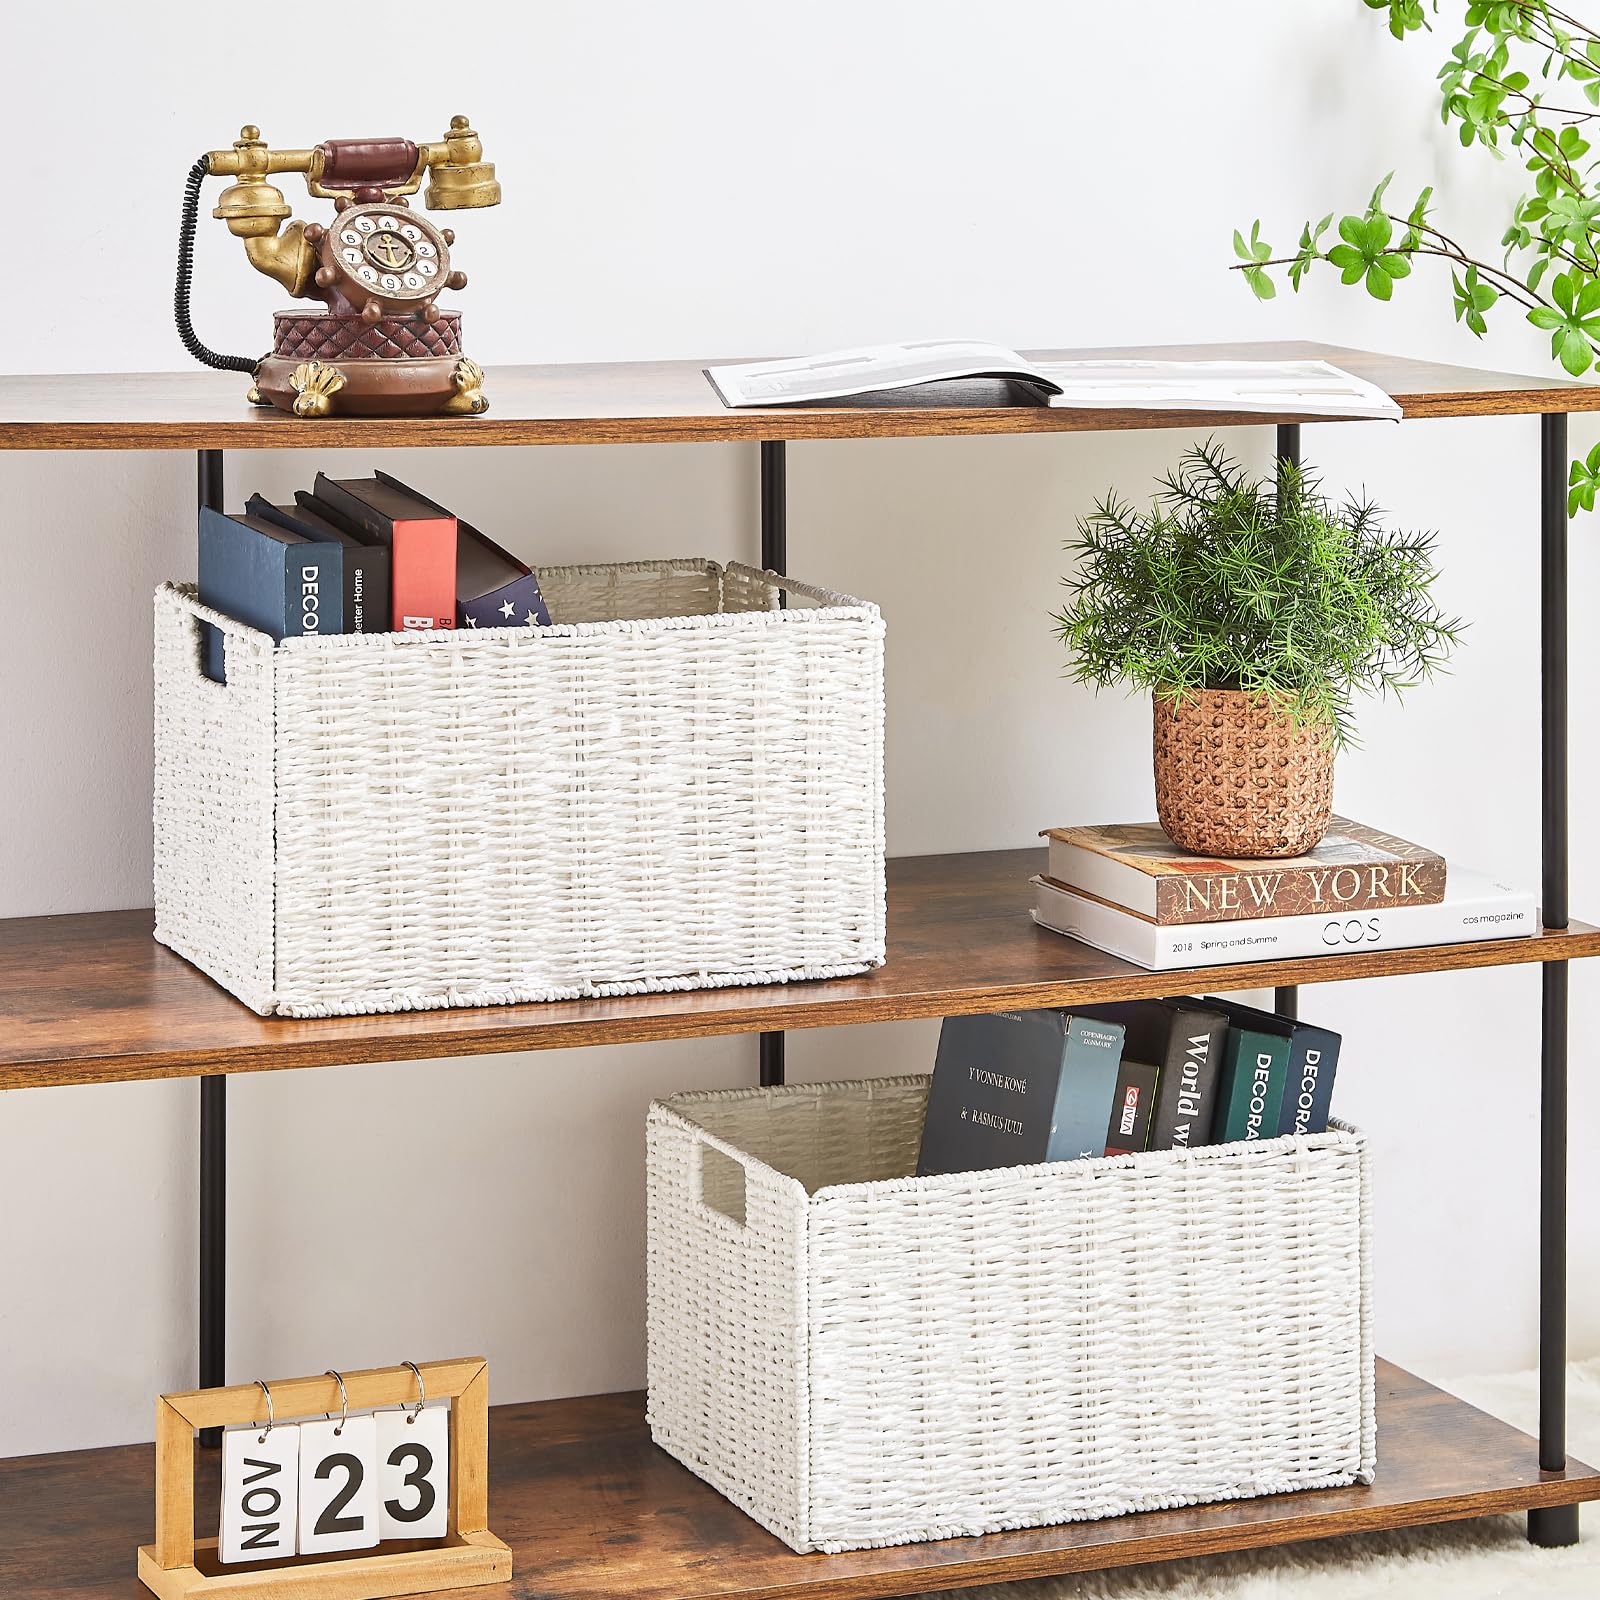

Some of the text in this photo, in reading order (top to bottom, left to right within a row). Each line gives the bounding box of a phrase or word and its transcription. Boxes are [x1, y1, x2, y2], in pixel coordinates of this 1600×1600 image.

[354, 569, 364, 602] Home
[302, 566, 319, 636] DECO
[1184, 863, 1425, 912] NEW YORK
[1322, 917, 1382, 946] COS
[1462, 911, 1525, 925] cos magazine
[1172, 936, 1278, 953] 2018 Spring and Summe
[1080, 1030, 1118, 1042] COPENHAGEN
[1004, 1076, 1027, 1095] KONÉ
[1177, 1032, 1211, 1117] World
[960, 1106, 1024, 1136] & RASMUS JUUL
[240, 1457, 282, 1551] NOV
